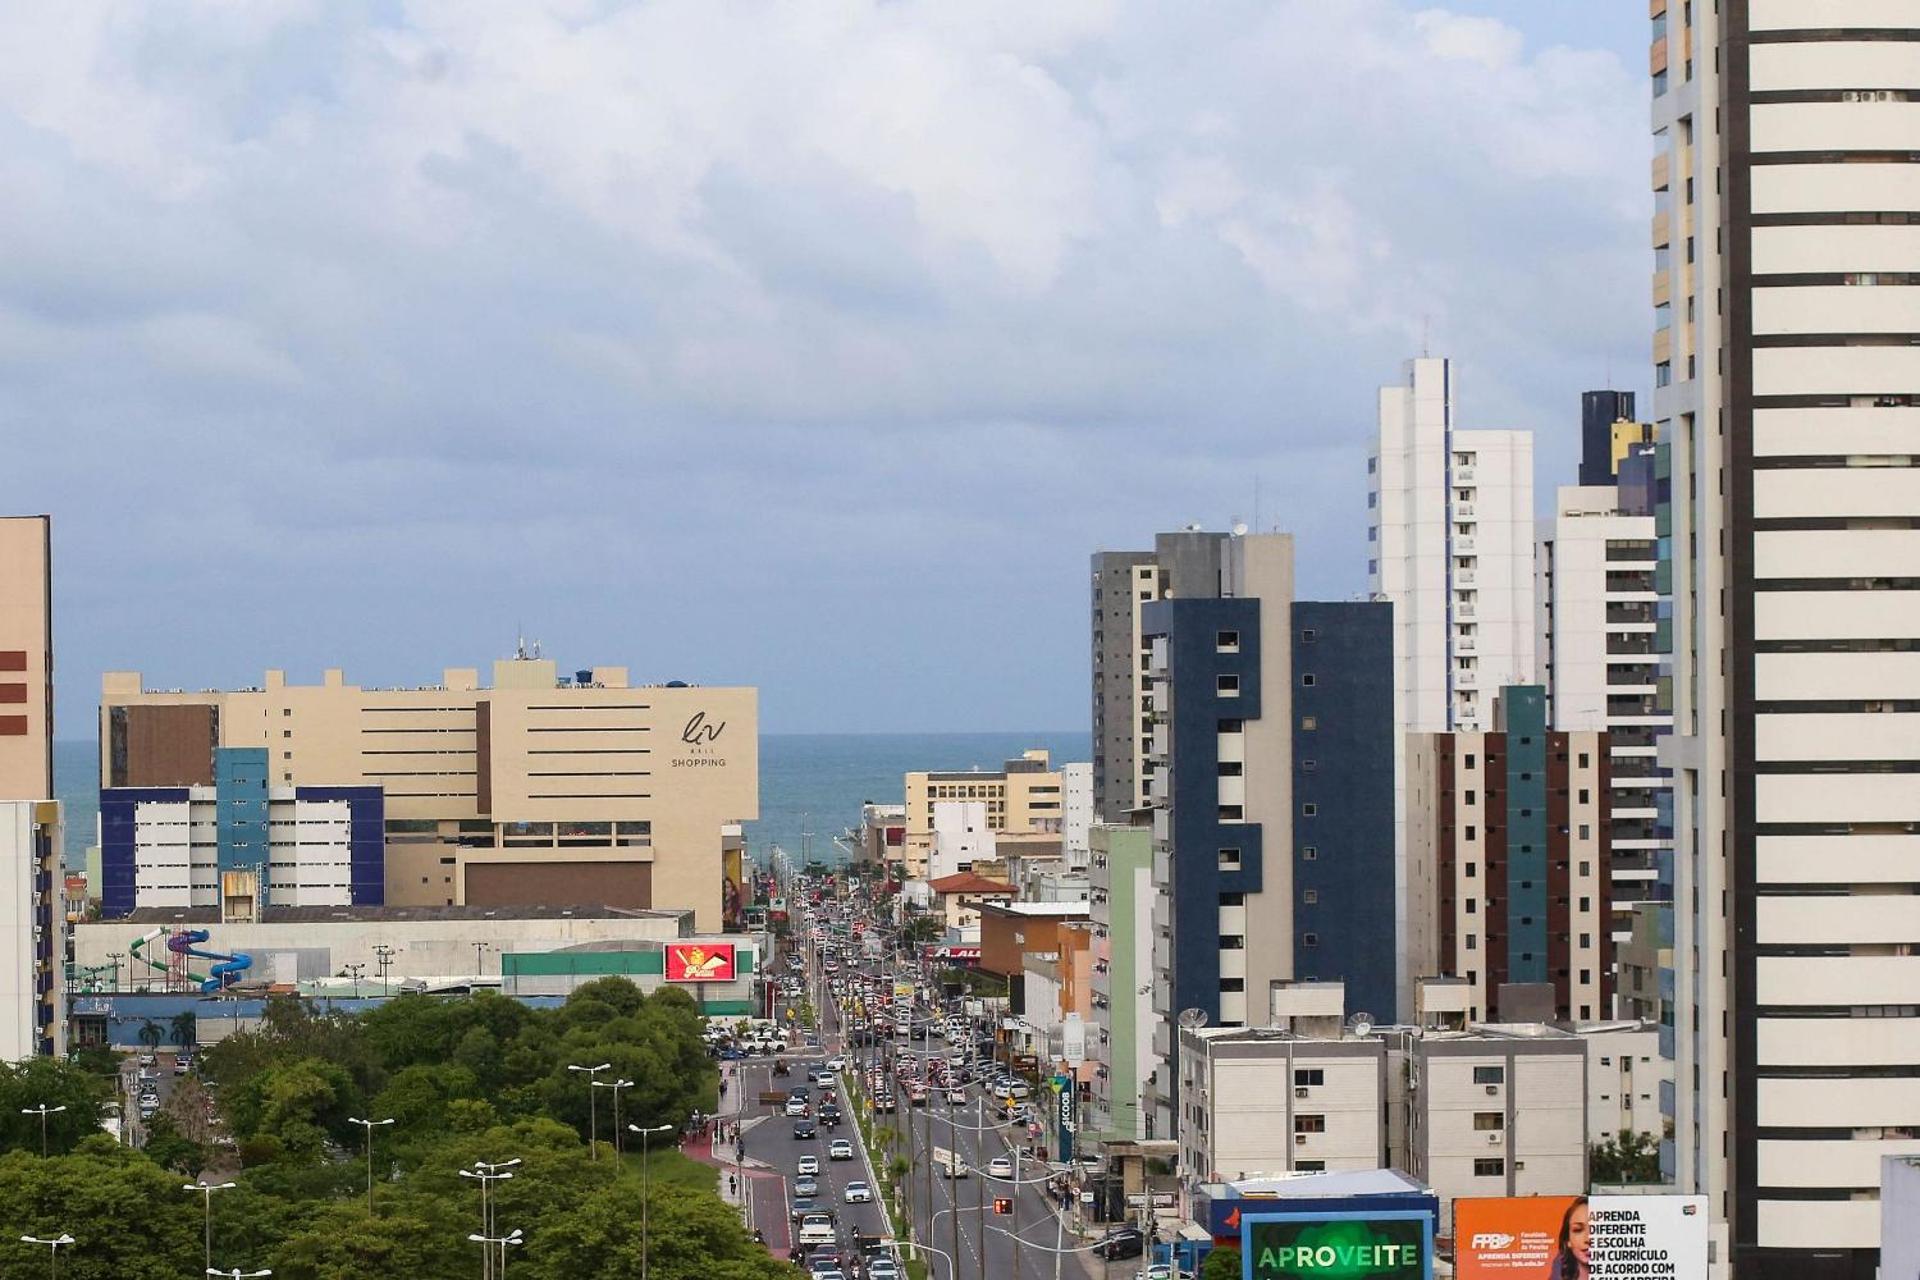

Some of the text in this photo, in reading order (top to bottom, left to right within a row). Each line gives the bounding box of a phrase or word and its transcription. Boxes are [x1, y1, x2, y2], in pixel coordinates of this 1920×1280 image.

[672, 759, 726, 767] SHOPPING
[1062, 1092, 1070, 1126] SICOOB
[1589, 1211, 1640, 1221] APRENDA
[1589, 1224, 1646, 1234] DIFERENTE
[1471, 1233, 1501, 1249] FPB
[1589, 1237, 1645, 1248] E ESCOLHA
[1258, 1245, 1417, 1267] APROVEITE
[1589, 1248, 1668, 1261] UM CURRÍCULO
[1589, 1263, 1675, 1274] DE ACORDO COM
